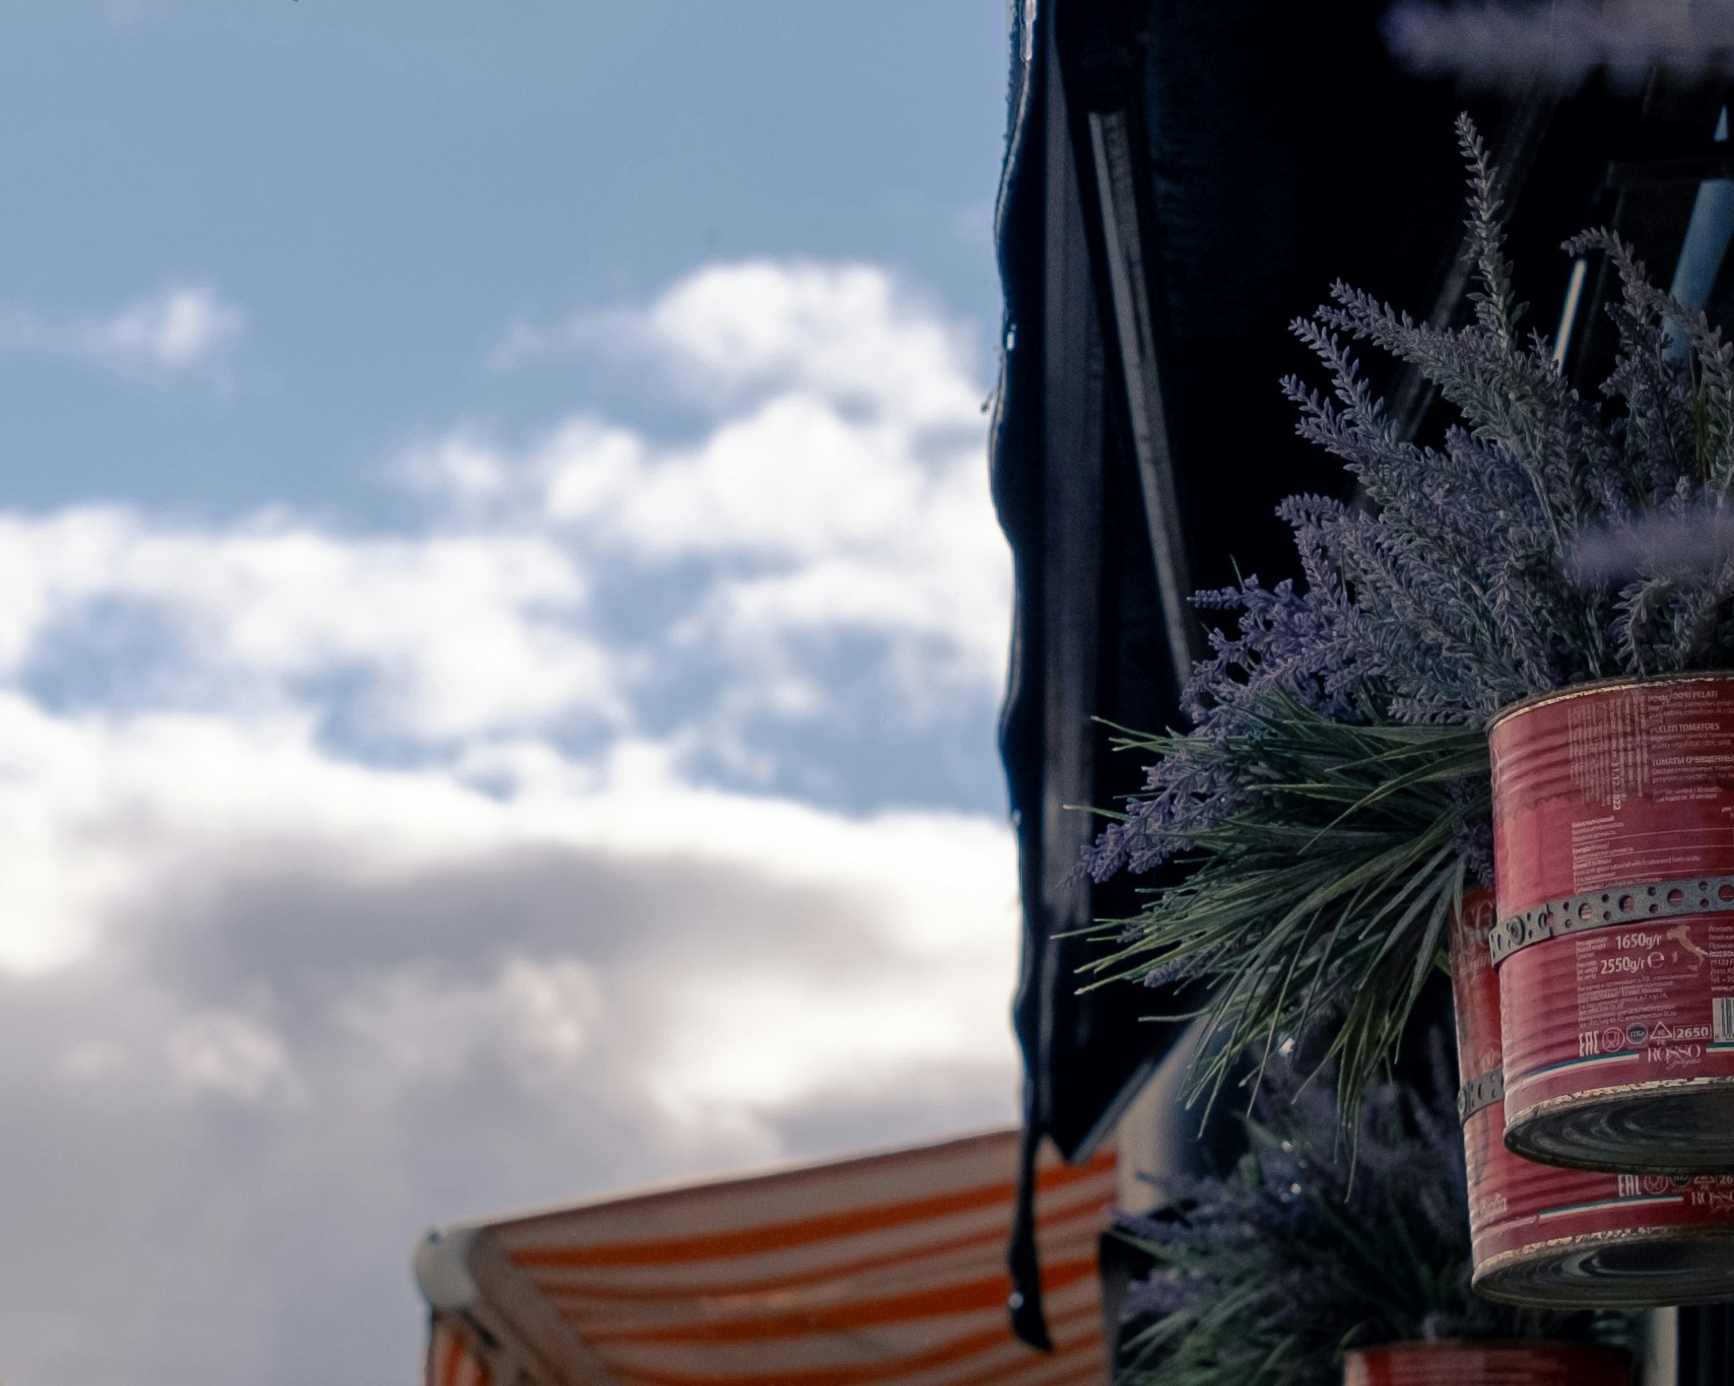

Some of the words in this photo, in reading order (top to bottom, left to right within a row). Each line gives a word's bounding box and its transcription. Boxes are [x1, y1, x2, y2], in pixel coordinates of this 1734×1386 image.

[1692, 691, 1719, 699] PELATI
[1679, 722, 1720, 732] TOMATOES
[1653, 756, 1685, 766] ТОМАТЫ
[1676, 1026, 1709, 1039] 2650
[1647, 1043, 1702, 1063] ROSSO
